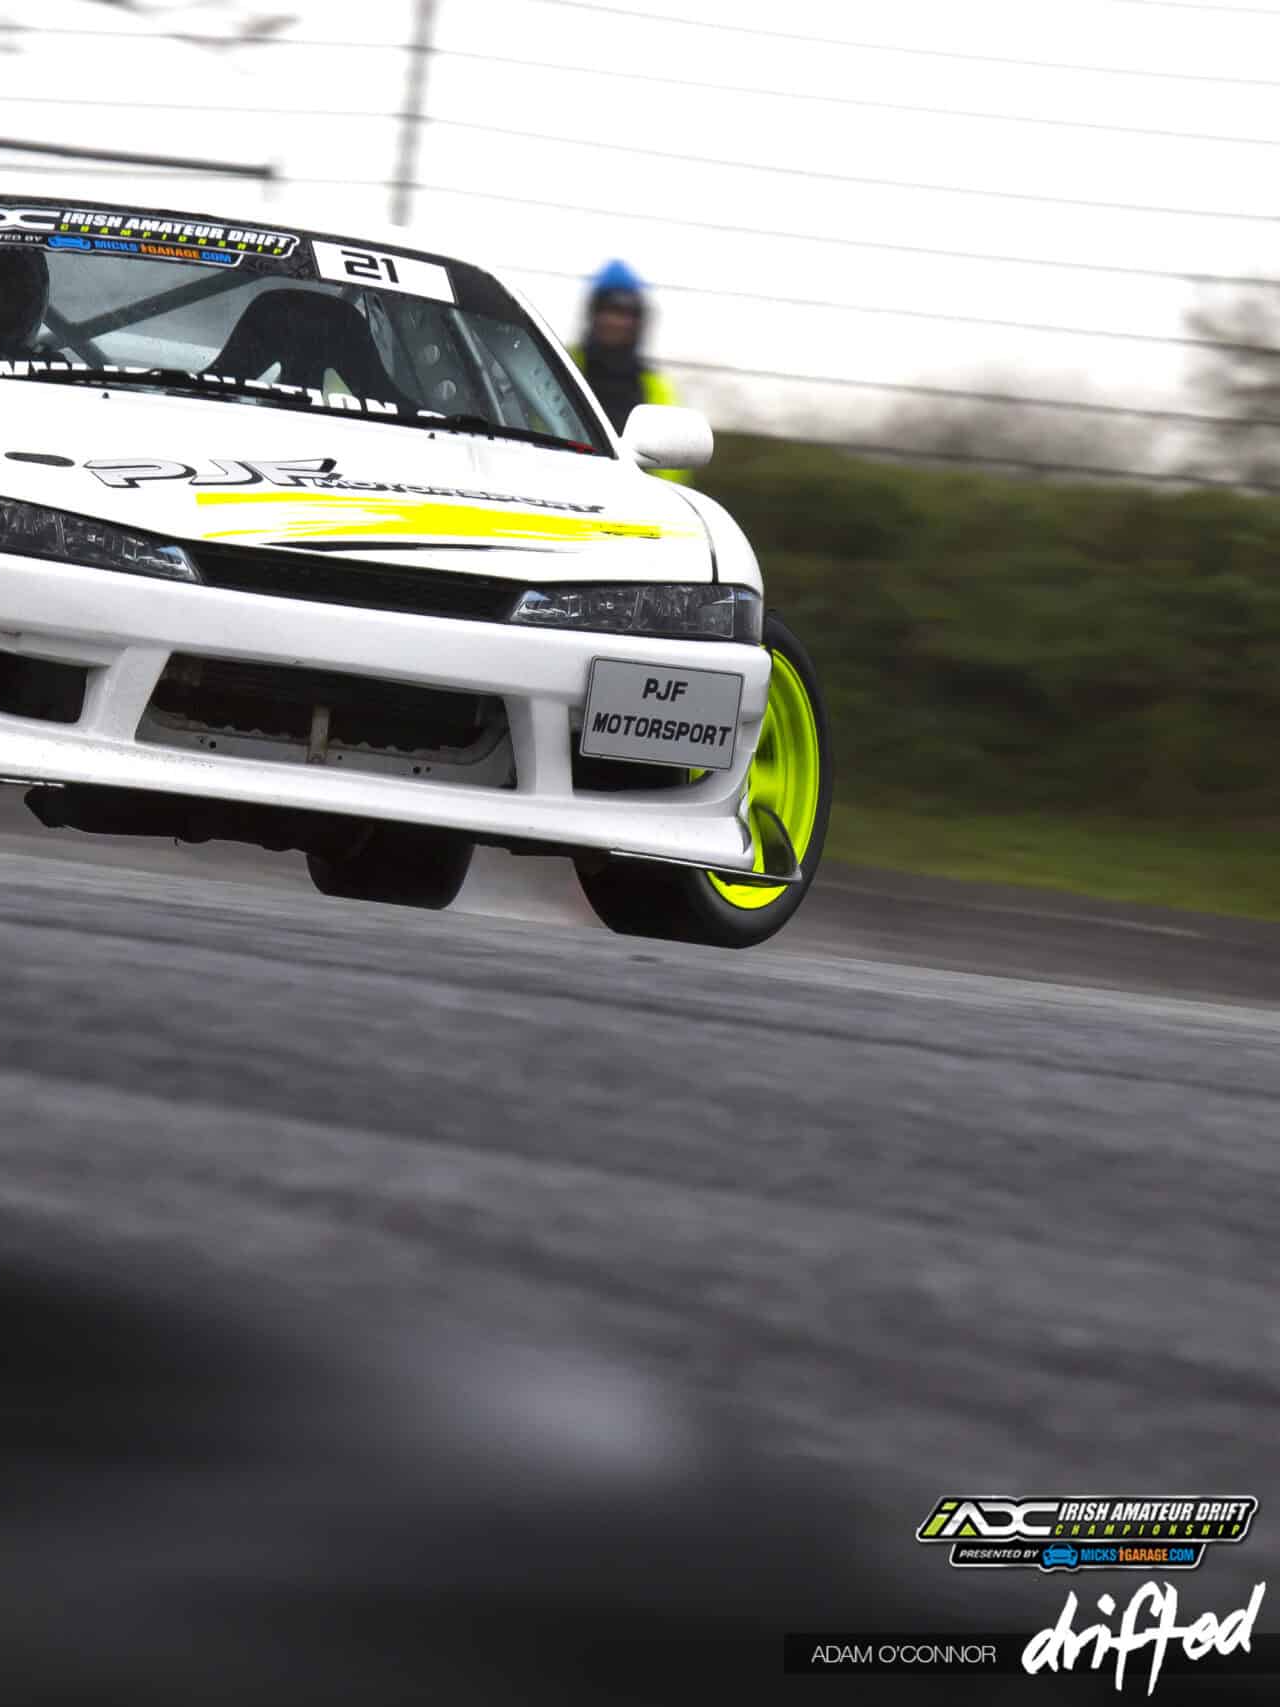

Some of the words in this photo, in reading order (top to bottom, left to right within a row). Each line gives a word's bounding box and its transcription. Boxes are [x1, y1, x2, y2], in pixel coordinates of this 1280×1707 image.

[24, 234, 43, 243] BY
[60, 223, 283, 255] CHAMPIONSHIP
[62, 211, 125, 228] IRISH
[126, 216, 226, 240] AMATEUR
[227, 229, 293, 249] DRIFT
[340, 249, 400, 284] 21
[83, 458, 343, 488] PJF
[642, 678, 689, 702] PJF
[592, 711, 732, 747] MOTORSPORT
